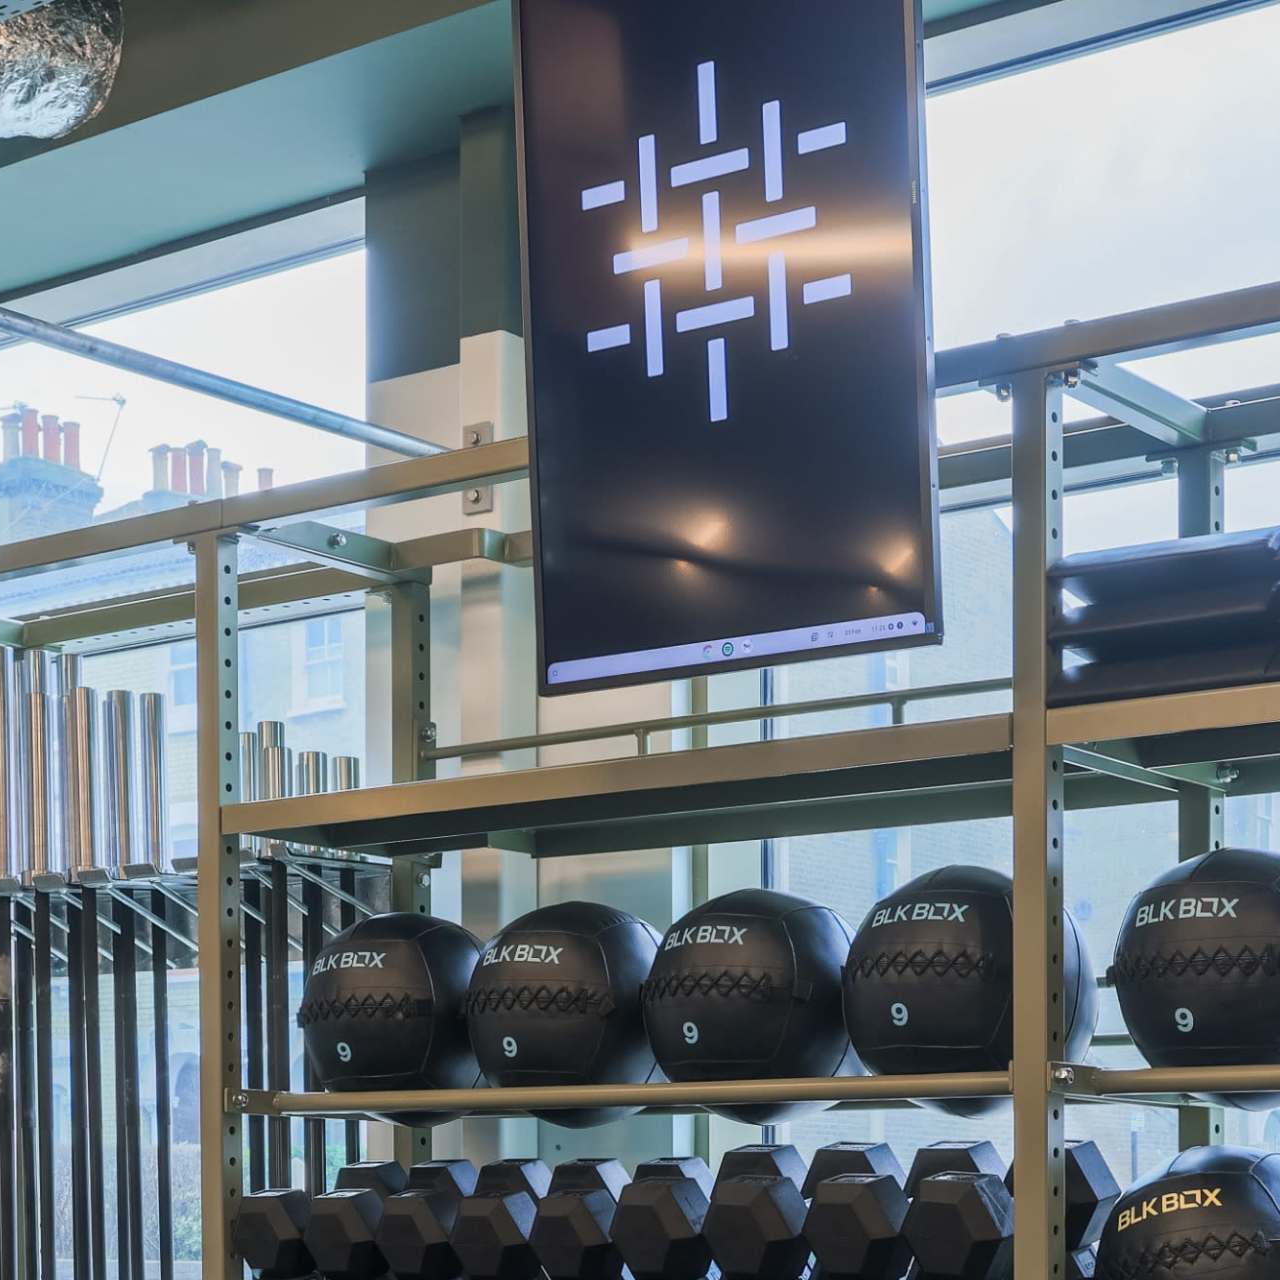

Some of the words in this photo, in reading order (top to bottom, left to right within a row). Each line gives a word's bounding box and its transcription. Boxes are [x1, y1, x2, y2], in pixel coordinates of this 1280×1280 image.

[1136, 900, 1176, 927] BLK
[1179, 898, 1238, 918] BOX
[891, 1003, 908, 1025] 9
[1175, 1008, 1193, 1032] 9
[683, 1022, 698, 1043] 9
[337, 1042, 351, 1061] 9
[503, 1037, 517, 1057] 9
[1118, 1197, 1160, 1230] BLK
[1162, 1189, 1222, 1213] BOX
